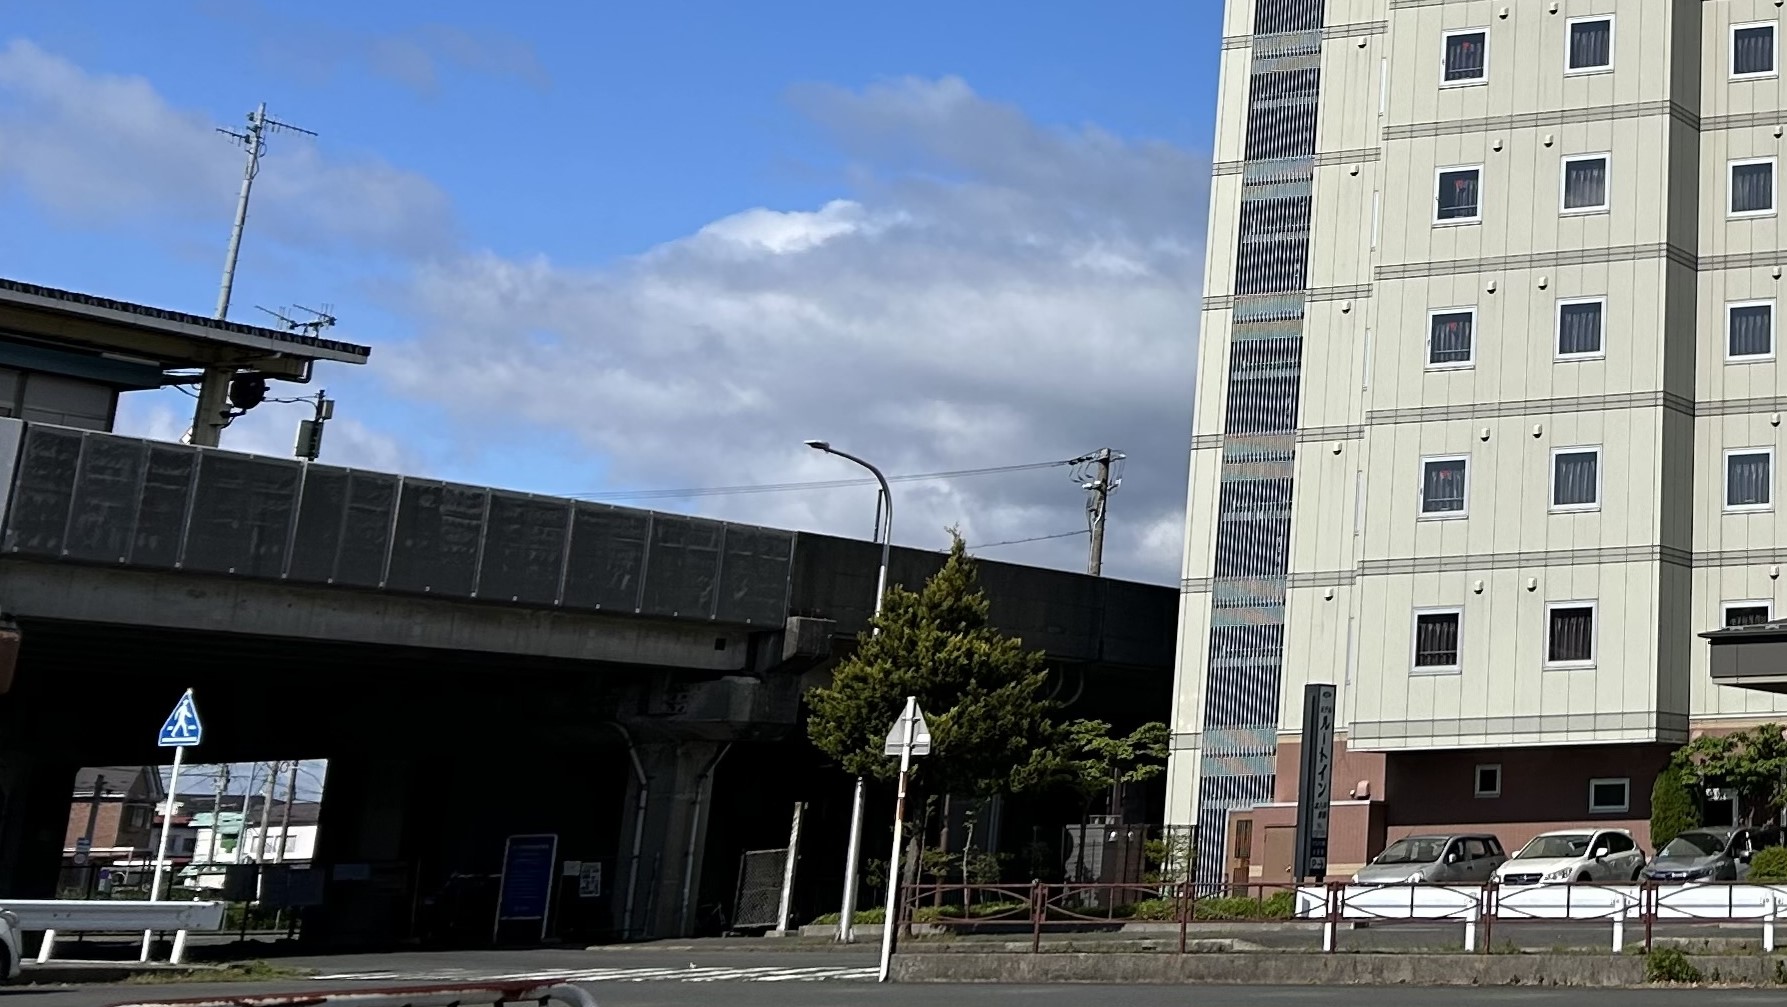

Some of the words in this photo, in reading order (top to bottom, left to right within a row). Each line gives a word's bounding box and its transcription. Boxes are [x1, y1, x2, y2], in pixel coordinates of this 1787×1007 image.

[1317, 715, 1331, 799] ルートイン
